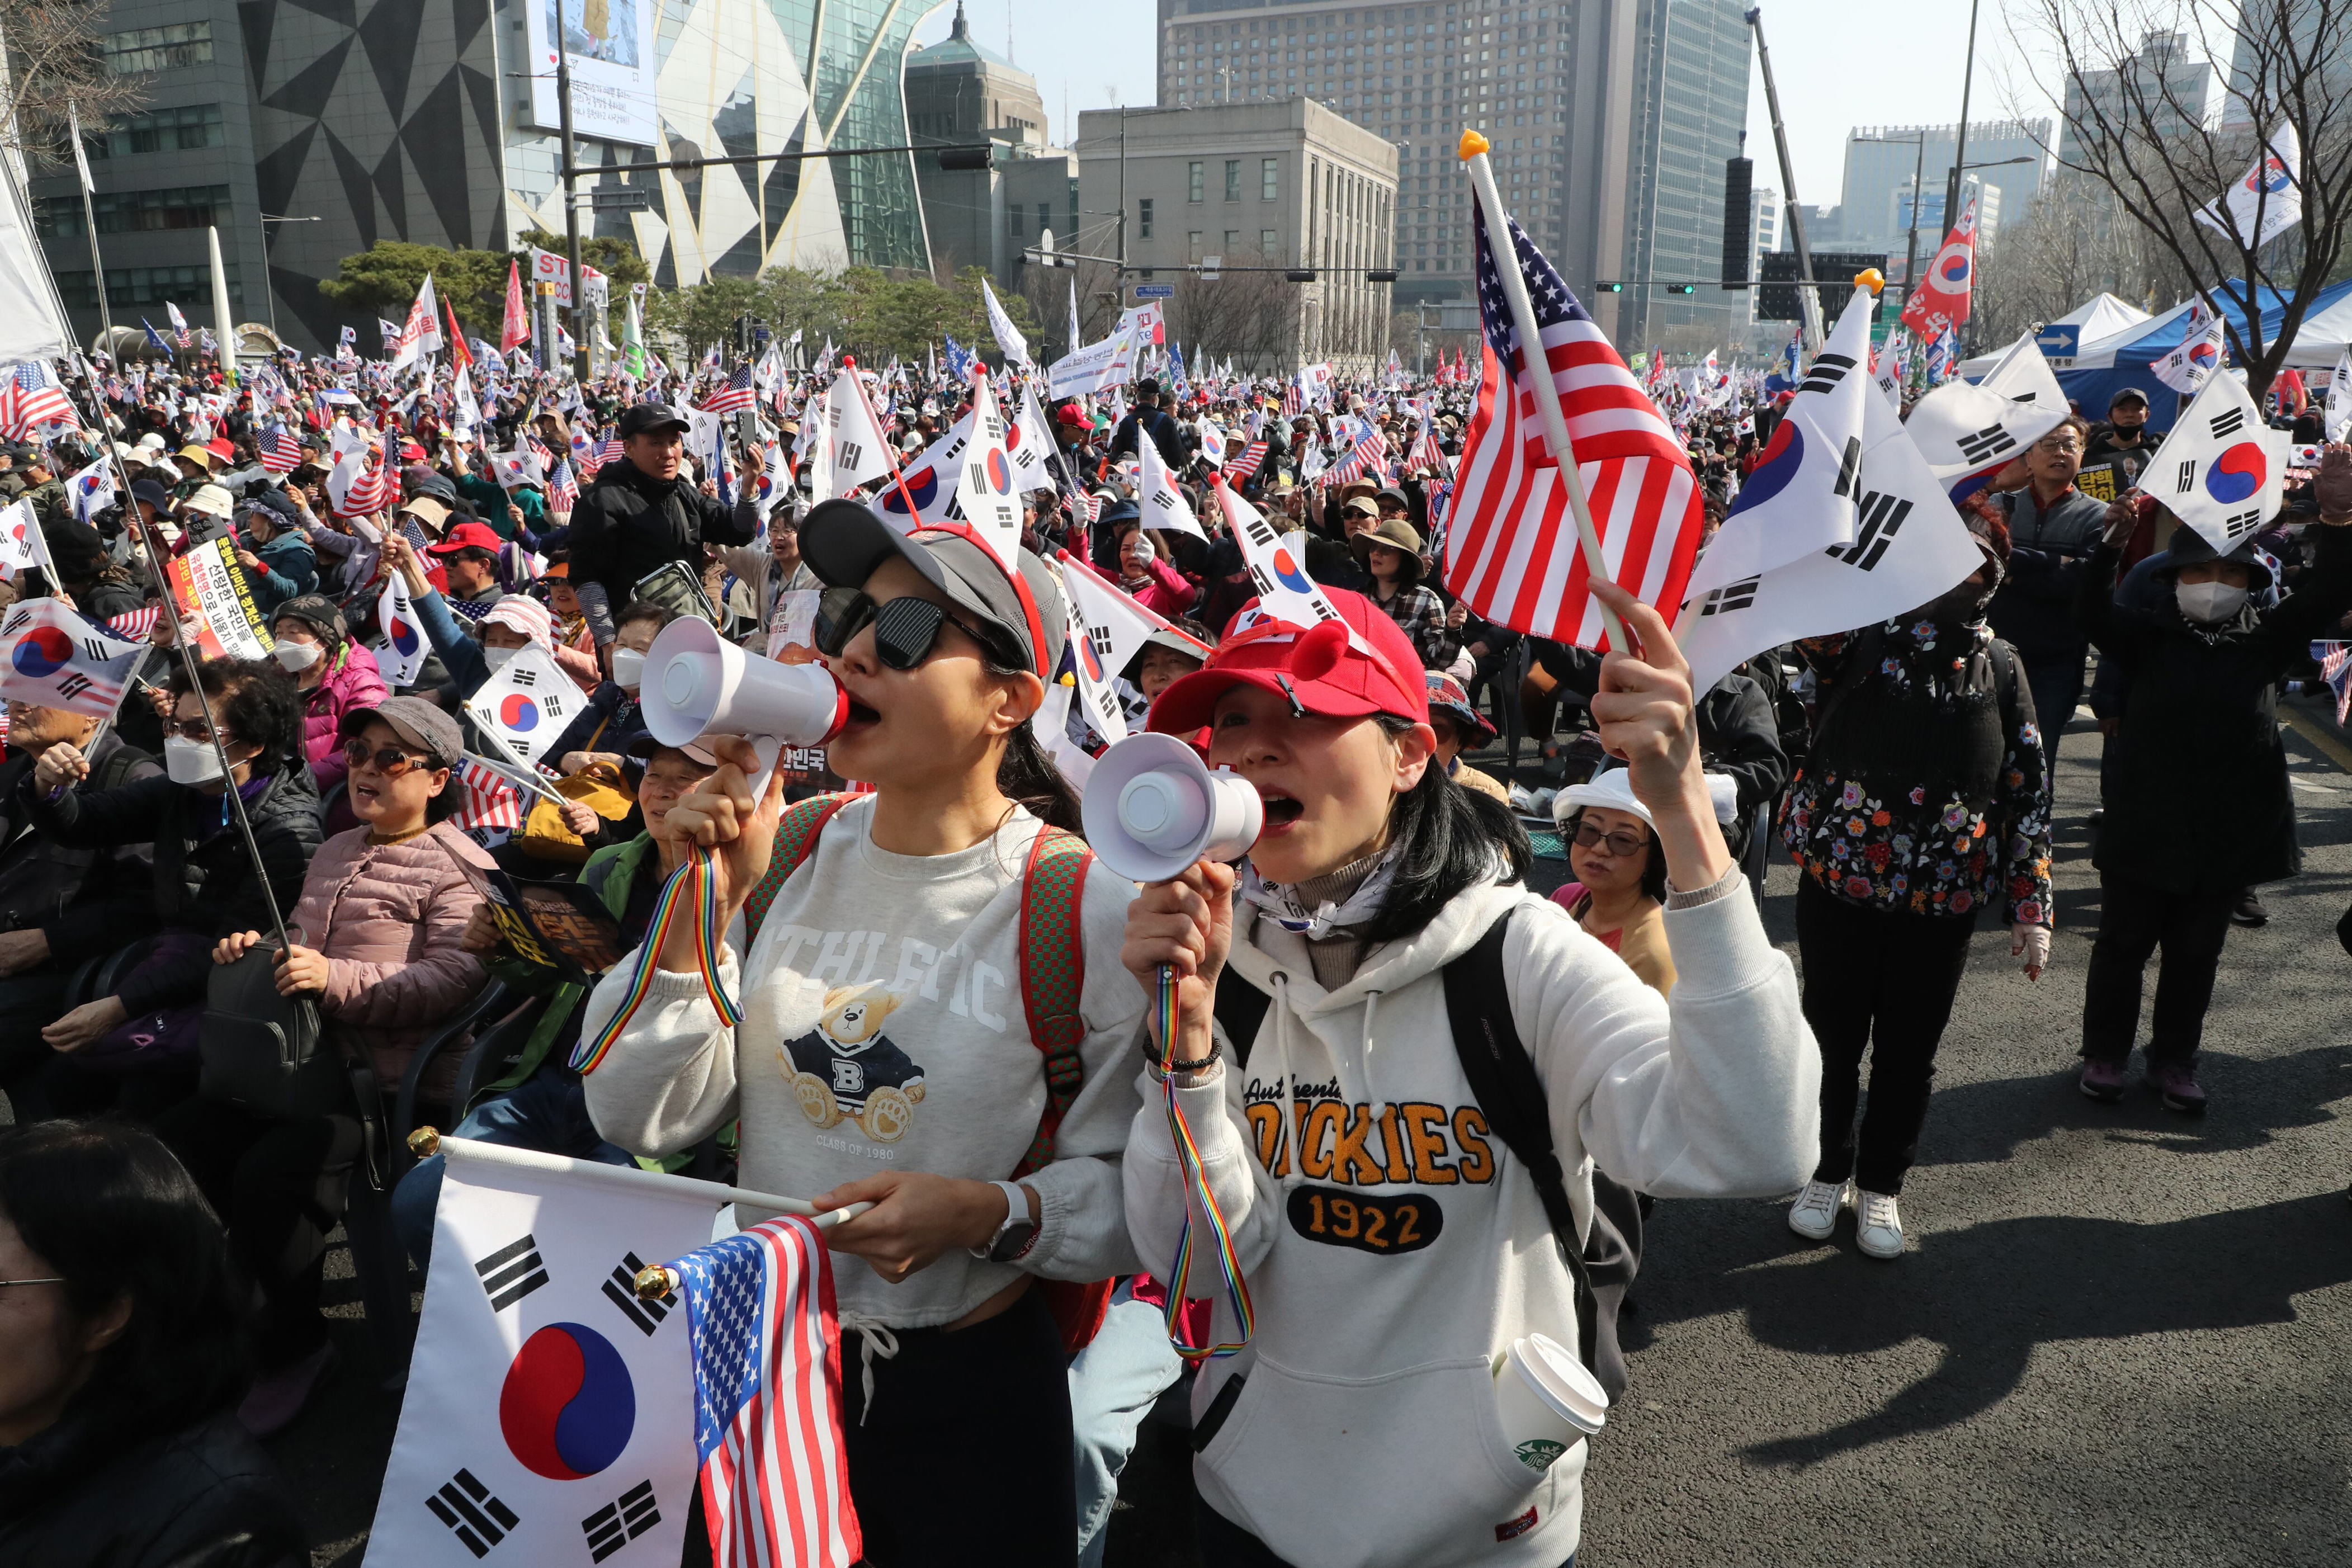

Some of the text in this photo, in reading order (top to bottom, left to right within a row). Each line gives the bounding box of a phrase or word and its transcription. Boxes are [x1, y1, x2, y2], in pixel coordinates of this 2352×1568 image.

[2078, 469, 2114, 489] 탄핵
[177, 557, 191, 582] 인민
[185, 583, 201, 607] 재판
[191, 553, 218, 613] 유혈혁명으로
[211, 612, 234, 643] 내몰지
[208, 564, 251, 642] 선량한 국민을
[218, 537, 277, 653] 문형배 이미선 정계선 정정미
[833, 1059, 864, 1093] B
[816, 1135, 894, 1161] CLASS OF 1980
[1245, 1099, 1496, 1186] DICKIES
[1309, 1194, 1421, 1248] 1922
